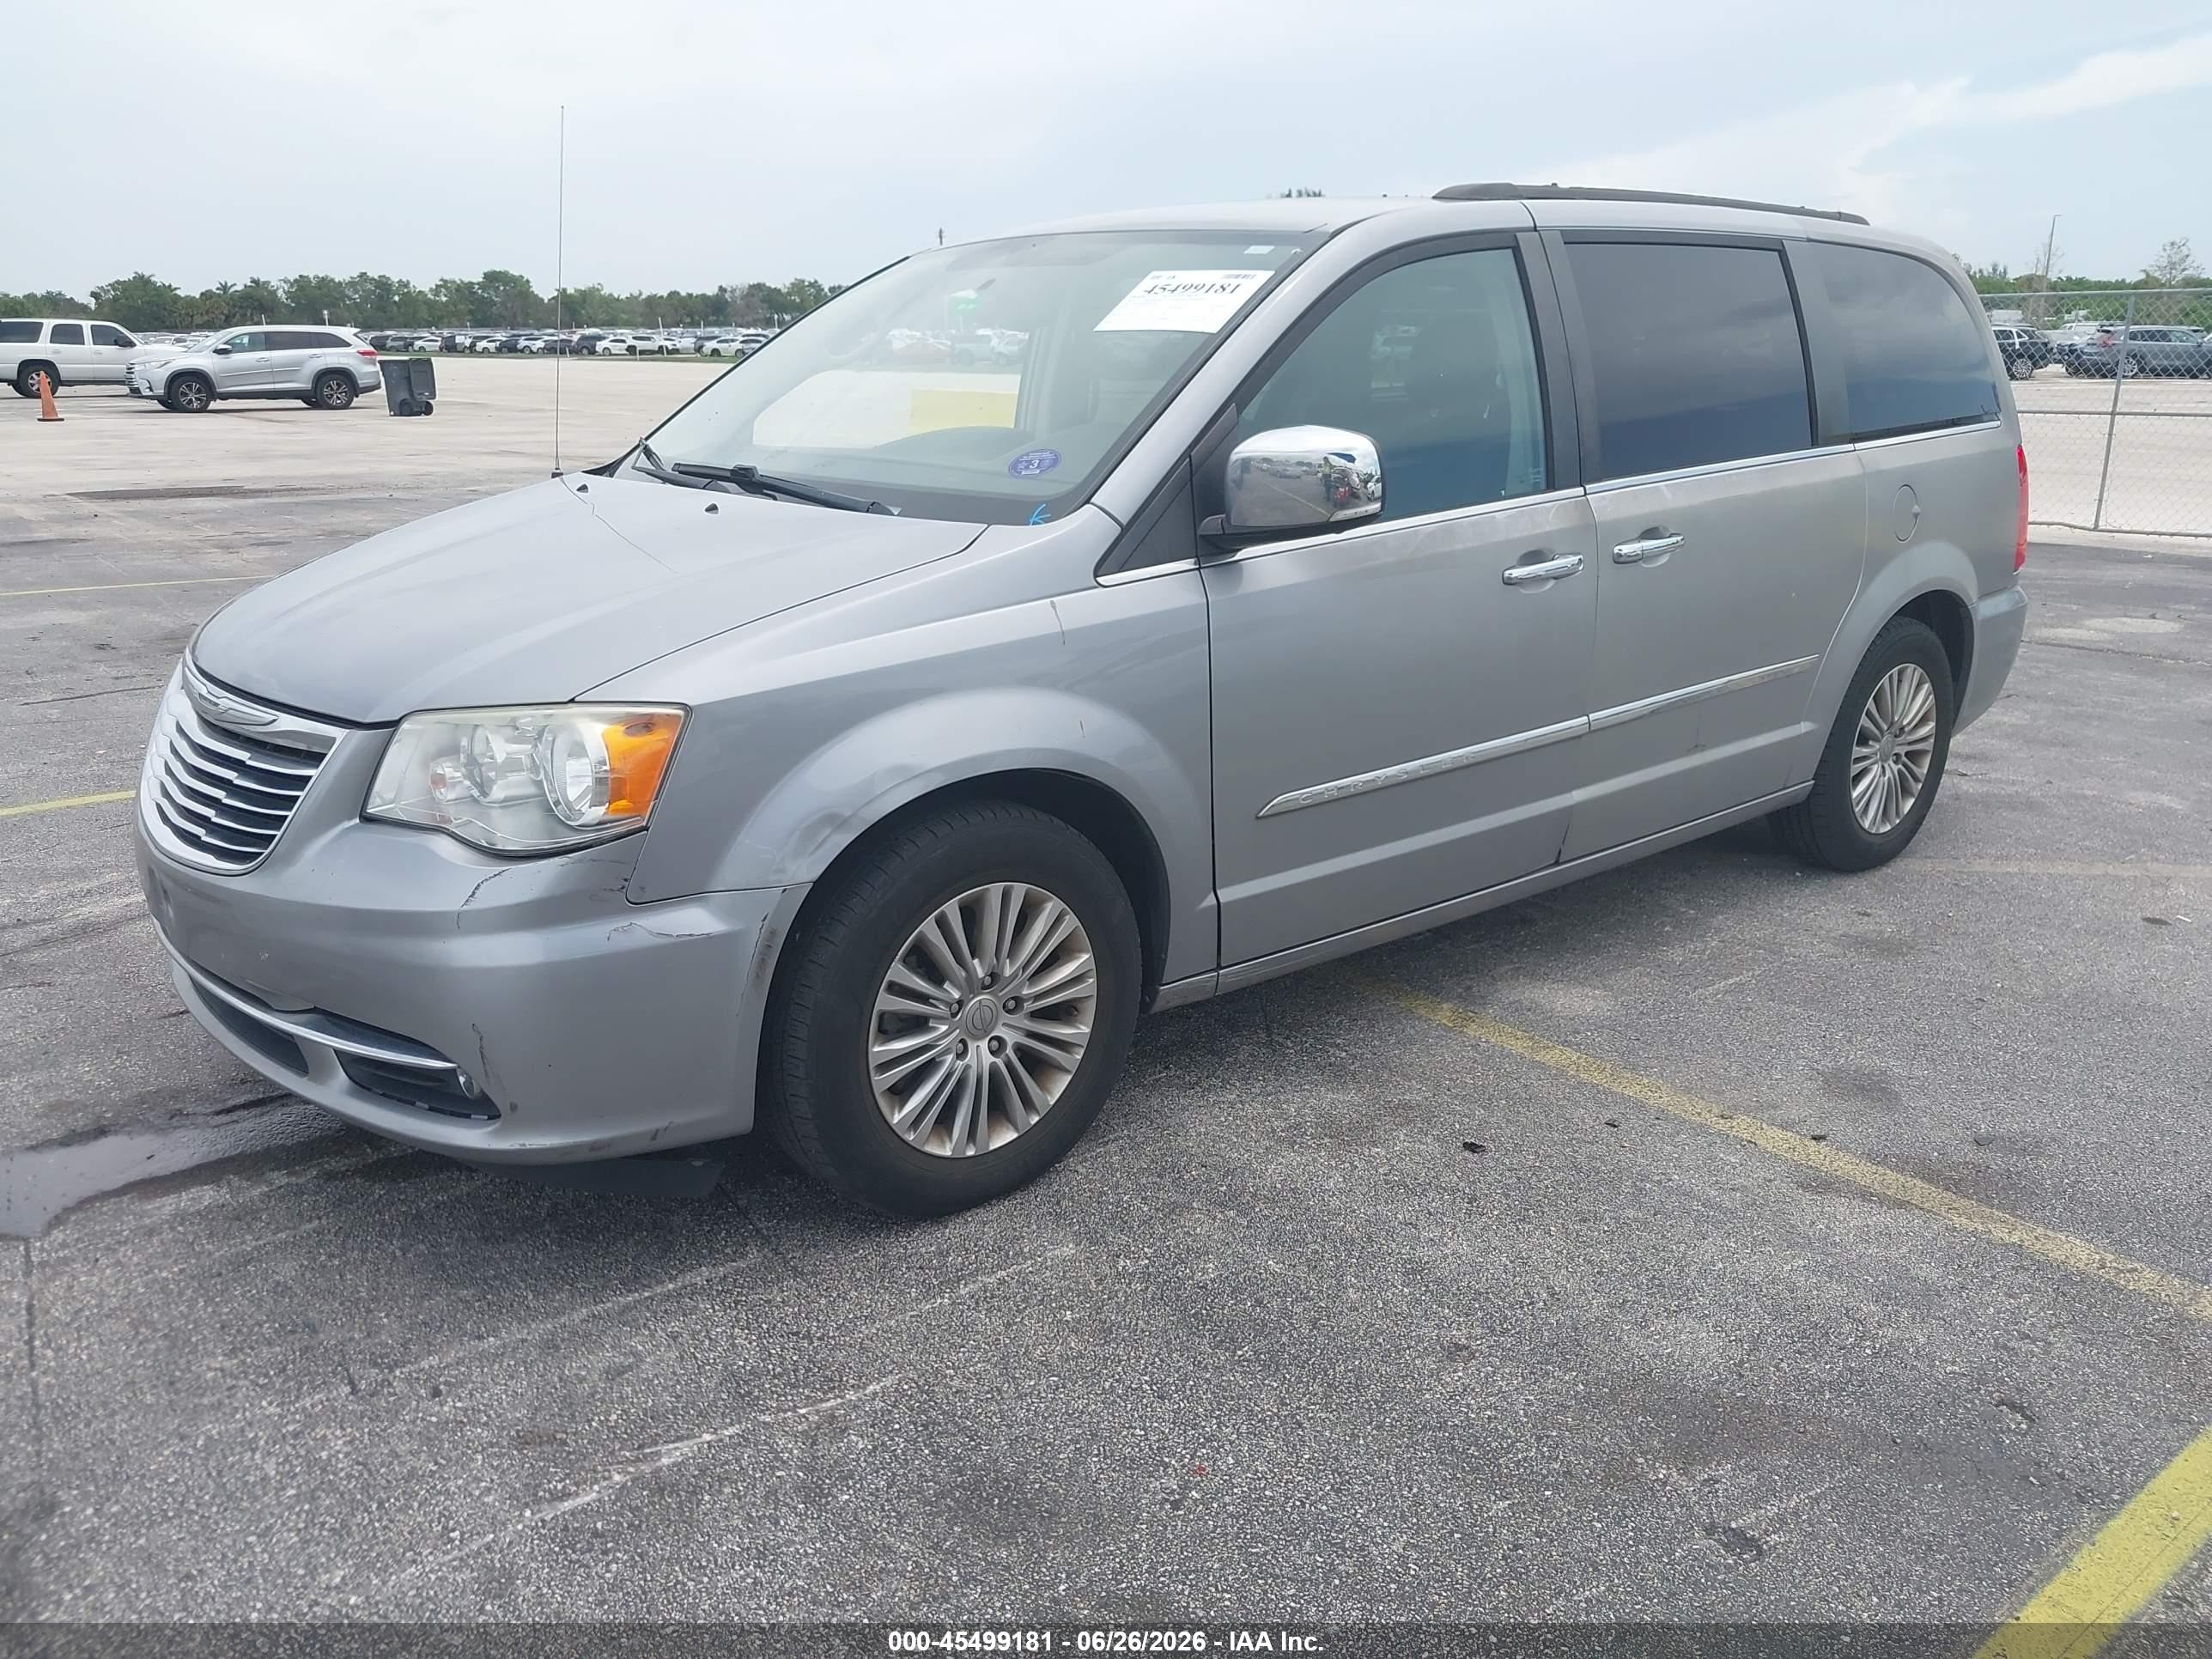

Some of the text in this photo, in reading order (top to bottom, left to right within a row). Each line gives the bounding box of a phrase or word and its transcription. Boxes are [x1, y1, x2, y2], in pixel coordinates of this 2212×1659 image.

[1144, 283, 1243, 295] 45499181
[1029, 459, 1040, 469] 3
[1298, 753, 1476, 805] CHRYSLER
